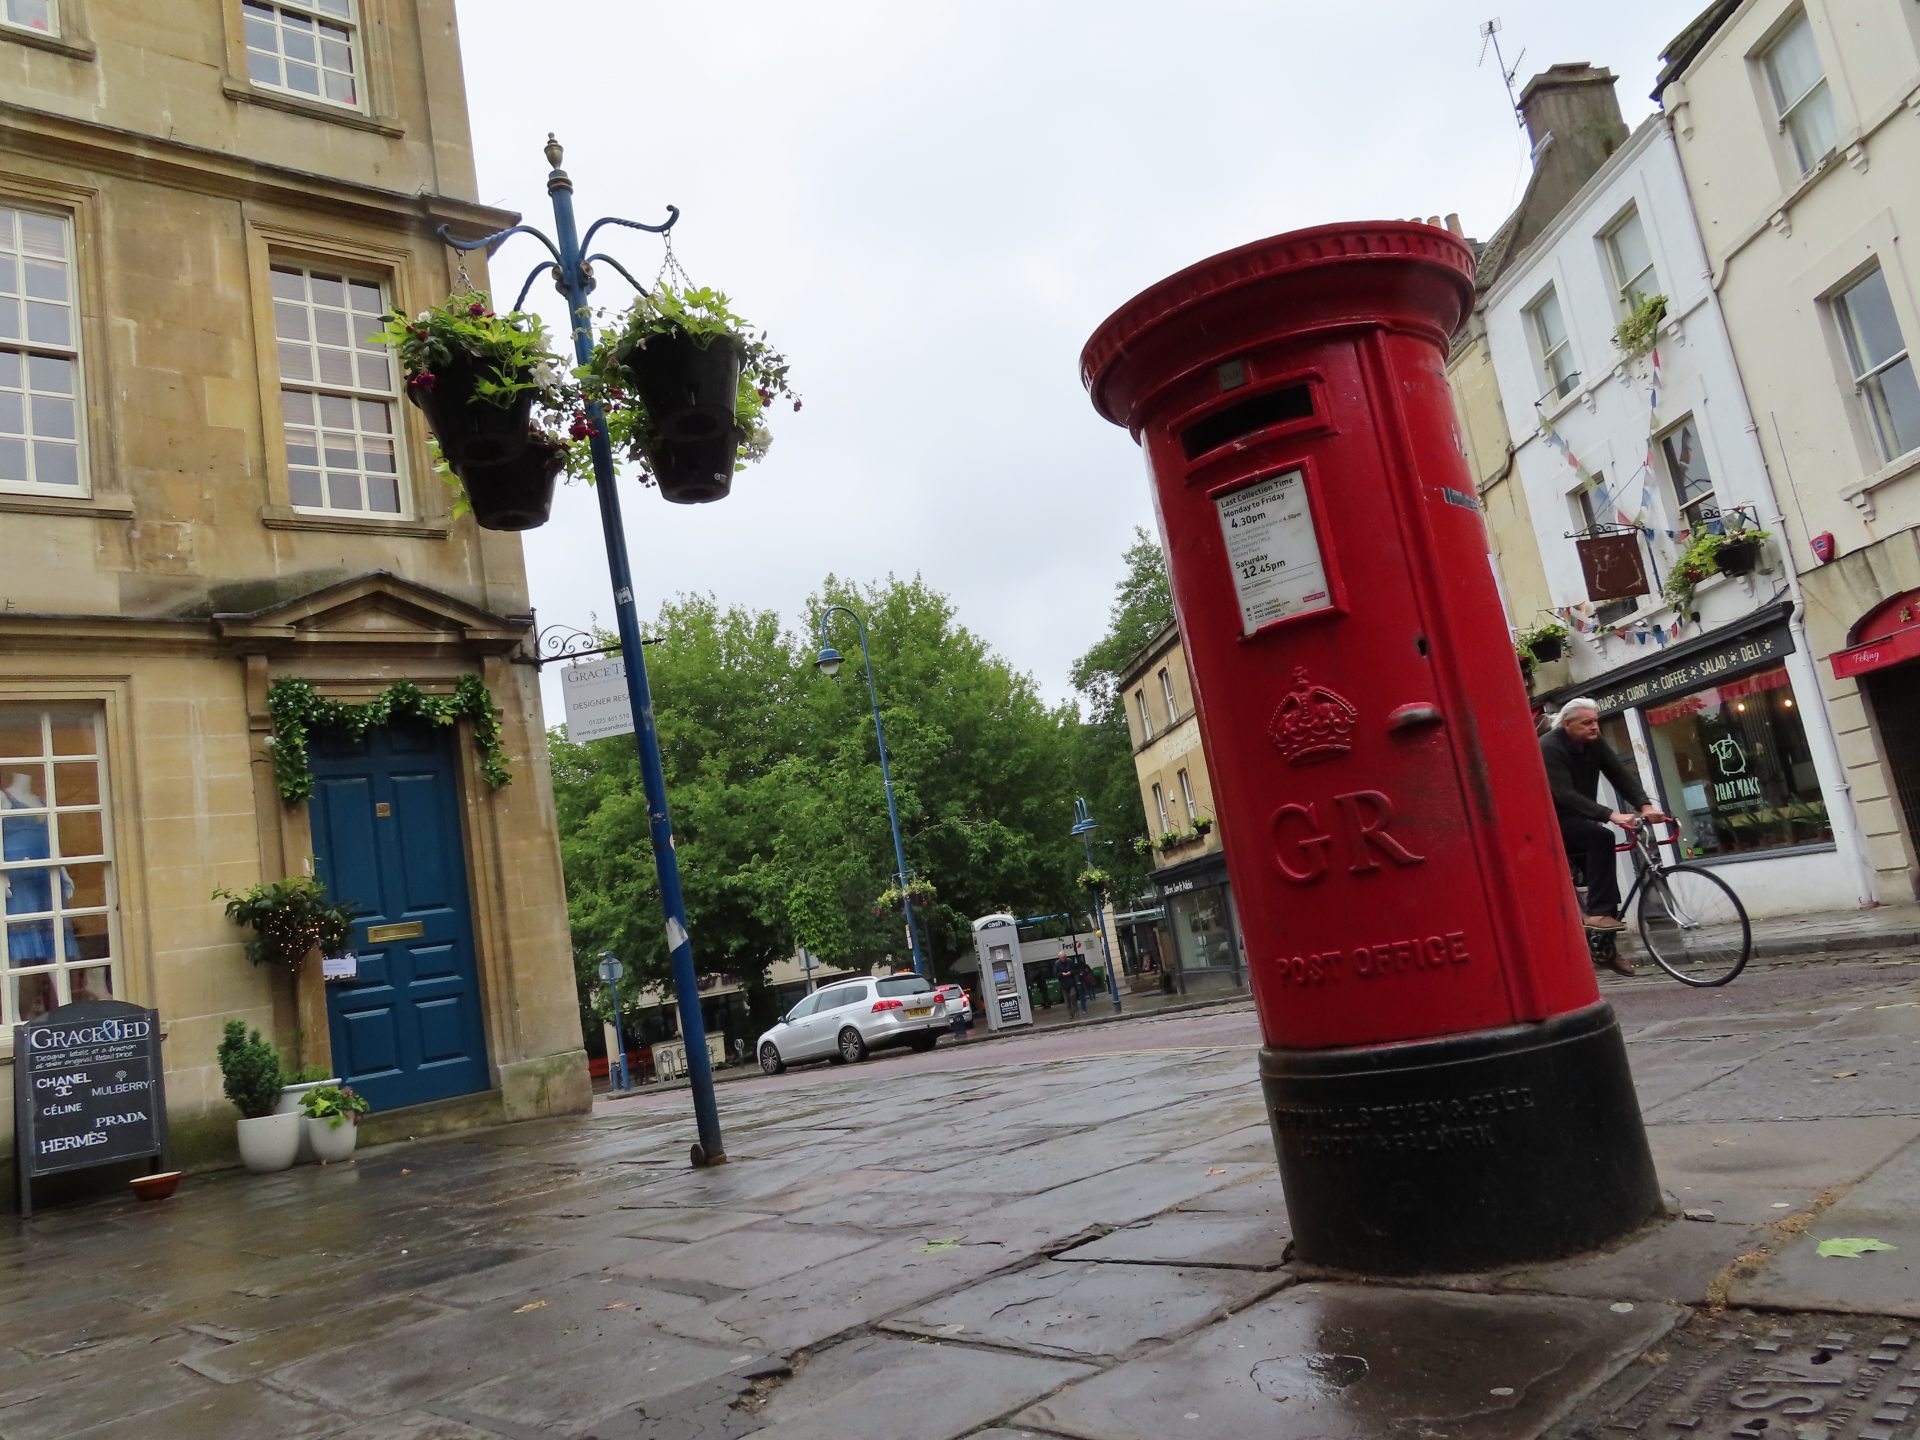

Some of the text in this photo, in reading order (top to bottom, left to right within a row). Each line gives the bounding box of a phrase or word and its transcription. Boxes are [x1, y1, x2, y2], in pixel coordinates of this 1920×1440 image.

[1220, 477, 1294, 509] Last Collection Time
[1223, 491, 1286, 519] Monday to Friday
[1231, 511, 1267, 529] 4.30pm
[1235, 552, 1269, 570] Saturday
[1242, 558, 1286, 579] 12.45pm
[568, 667, 610, 683] GRACE
[1626, 682, 1649, 702] CURRY
[1660, 668, 1689, 690] COFFEE
[1699, 654, 1727, 676] SALAD
[1740, 641, 1761, 662] DELI
[573, 696, 612, 711] DESIGNER
[1271, 789, 1425, 883] GR
[1276, 931, 1470, 985] POST OFFICE
[1000, 999, 1018, 1008] cash
[69, 1049, 90, 1058] labels
[108, 1044, 138, 1053] fraction
[36, 1072, 93, 1090] CHANEL
[91, 1080, 151, 1097] MULBERRY
[42, 1103, 83, 1116] CÉLINE
[95, 1111, 149, 1128] PRADA
